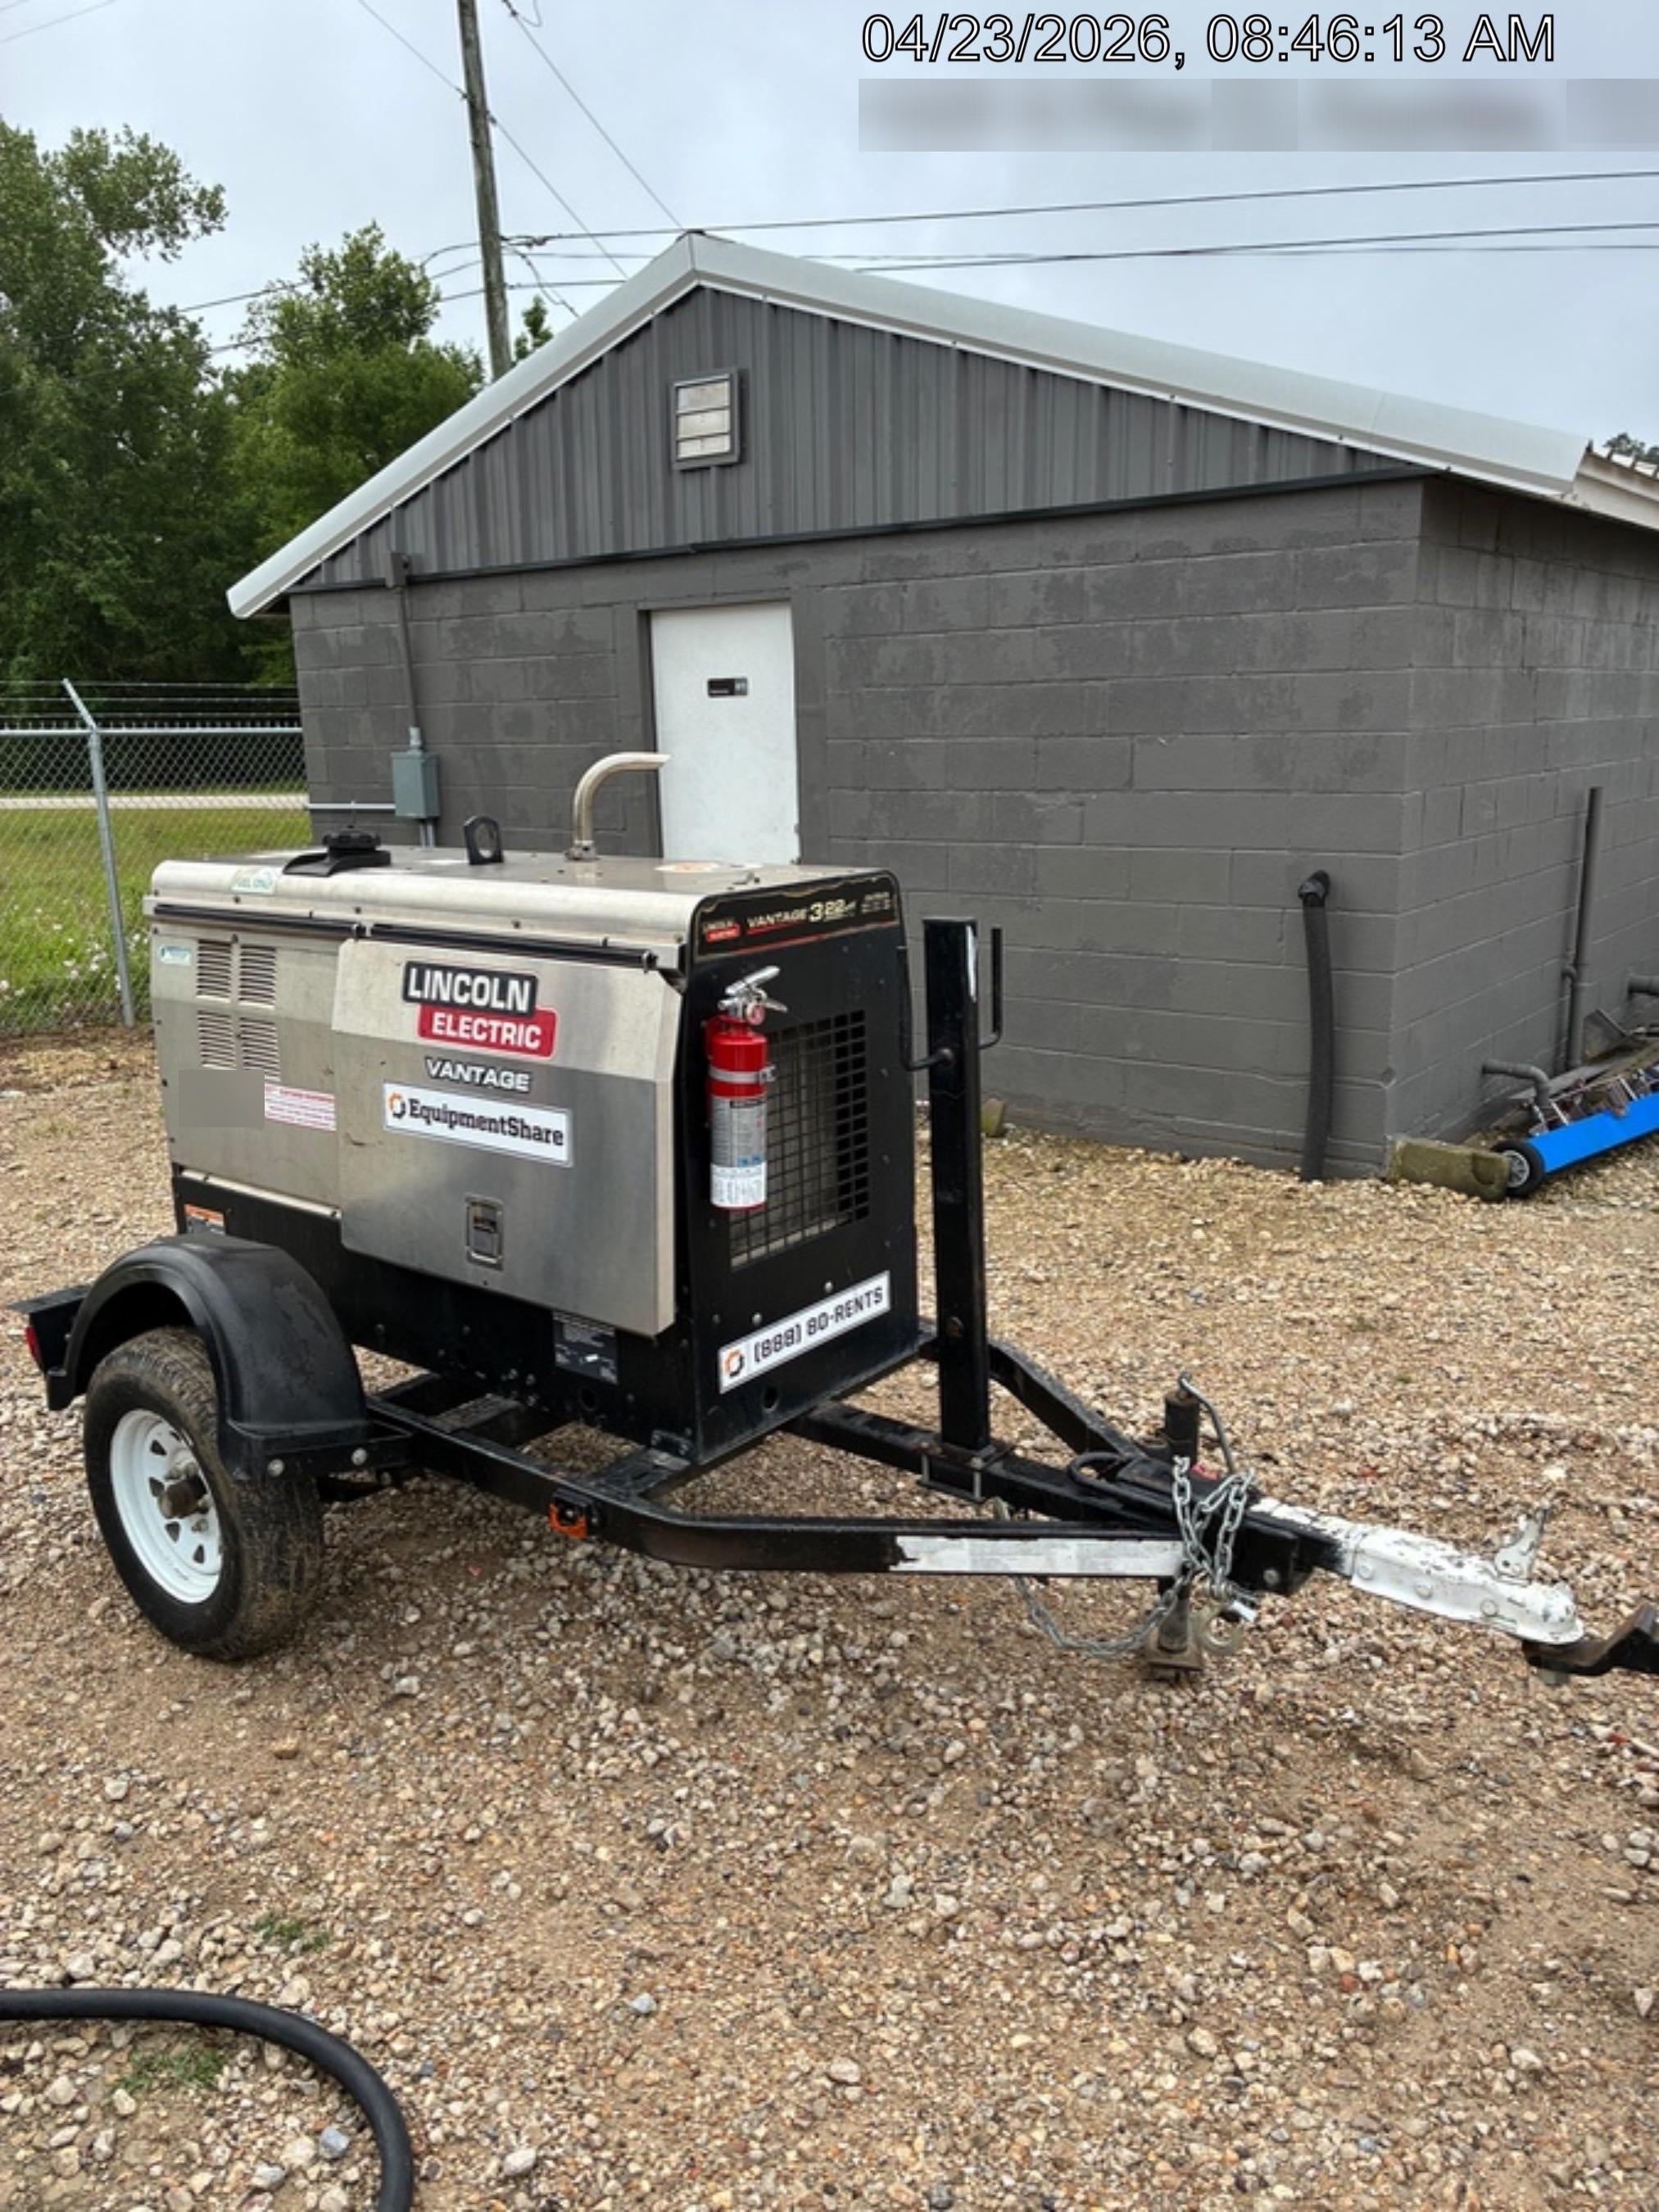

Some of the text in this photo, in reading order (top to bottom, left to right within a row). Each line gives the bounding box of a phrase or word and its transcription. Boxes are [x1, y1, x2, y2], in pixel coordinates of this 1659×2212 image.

[407, 967, 531, 1013] LINCOLN
[431, 1012, 542, 1049] ELECTRIC
[424, 1056, 532, 1093] VANTAGE
[407, 1098, 565, 1146] EquipmentShare
